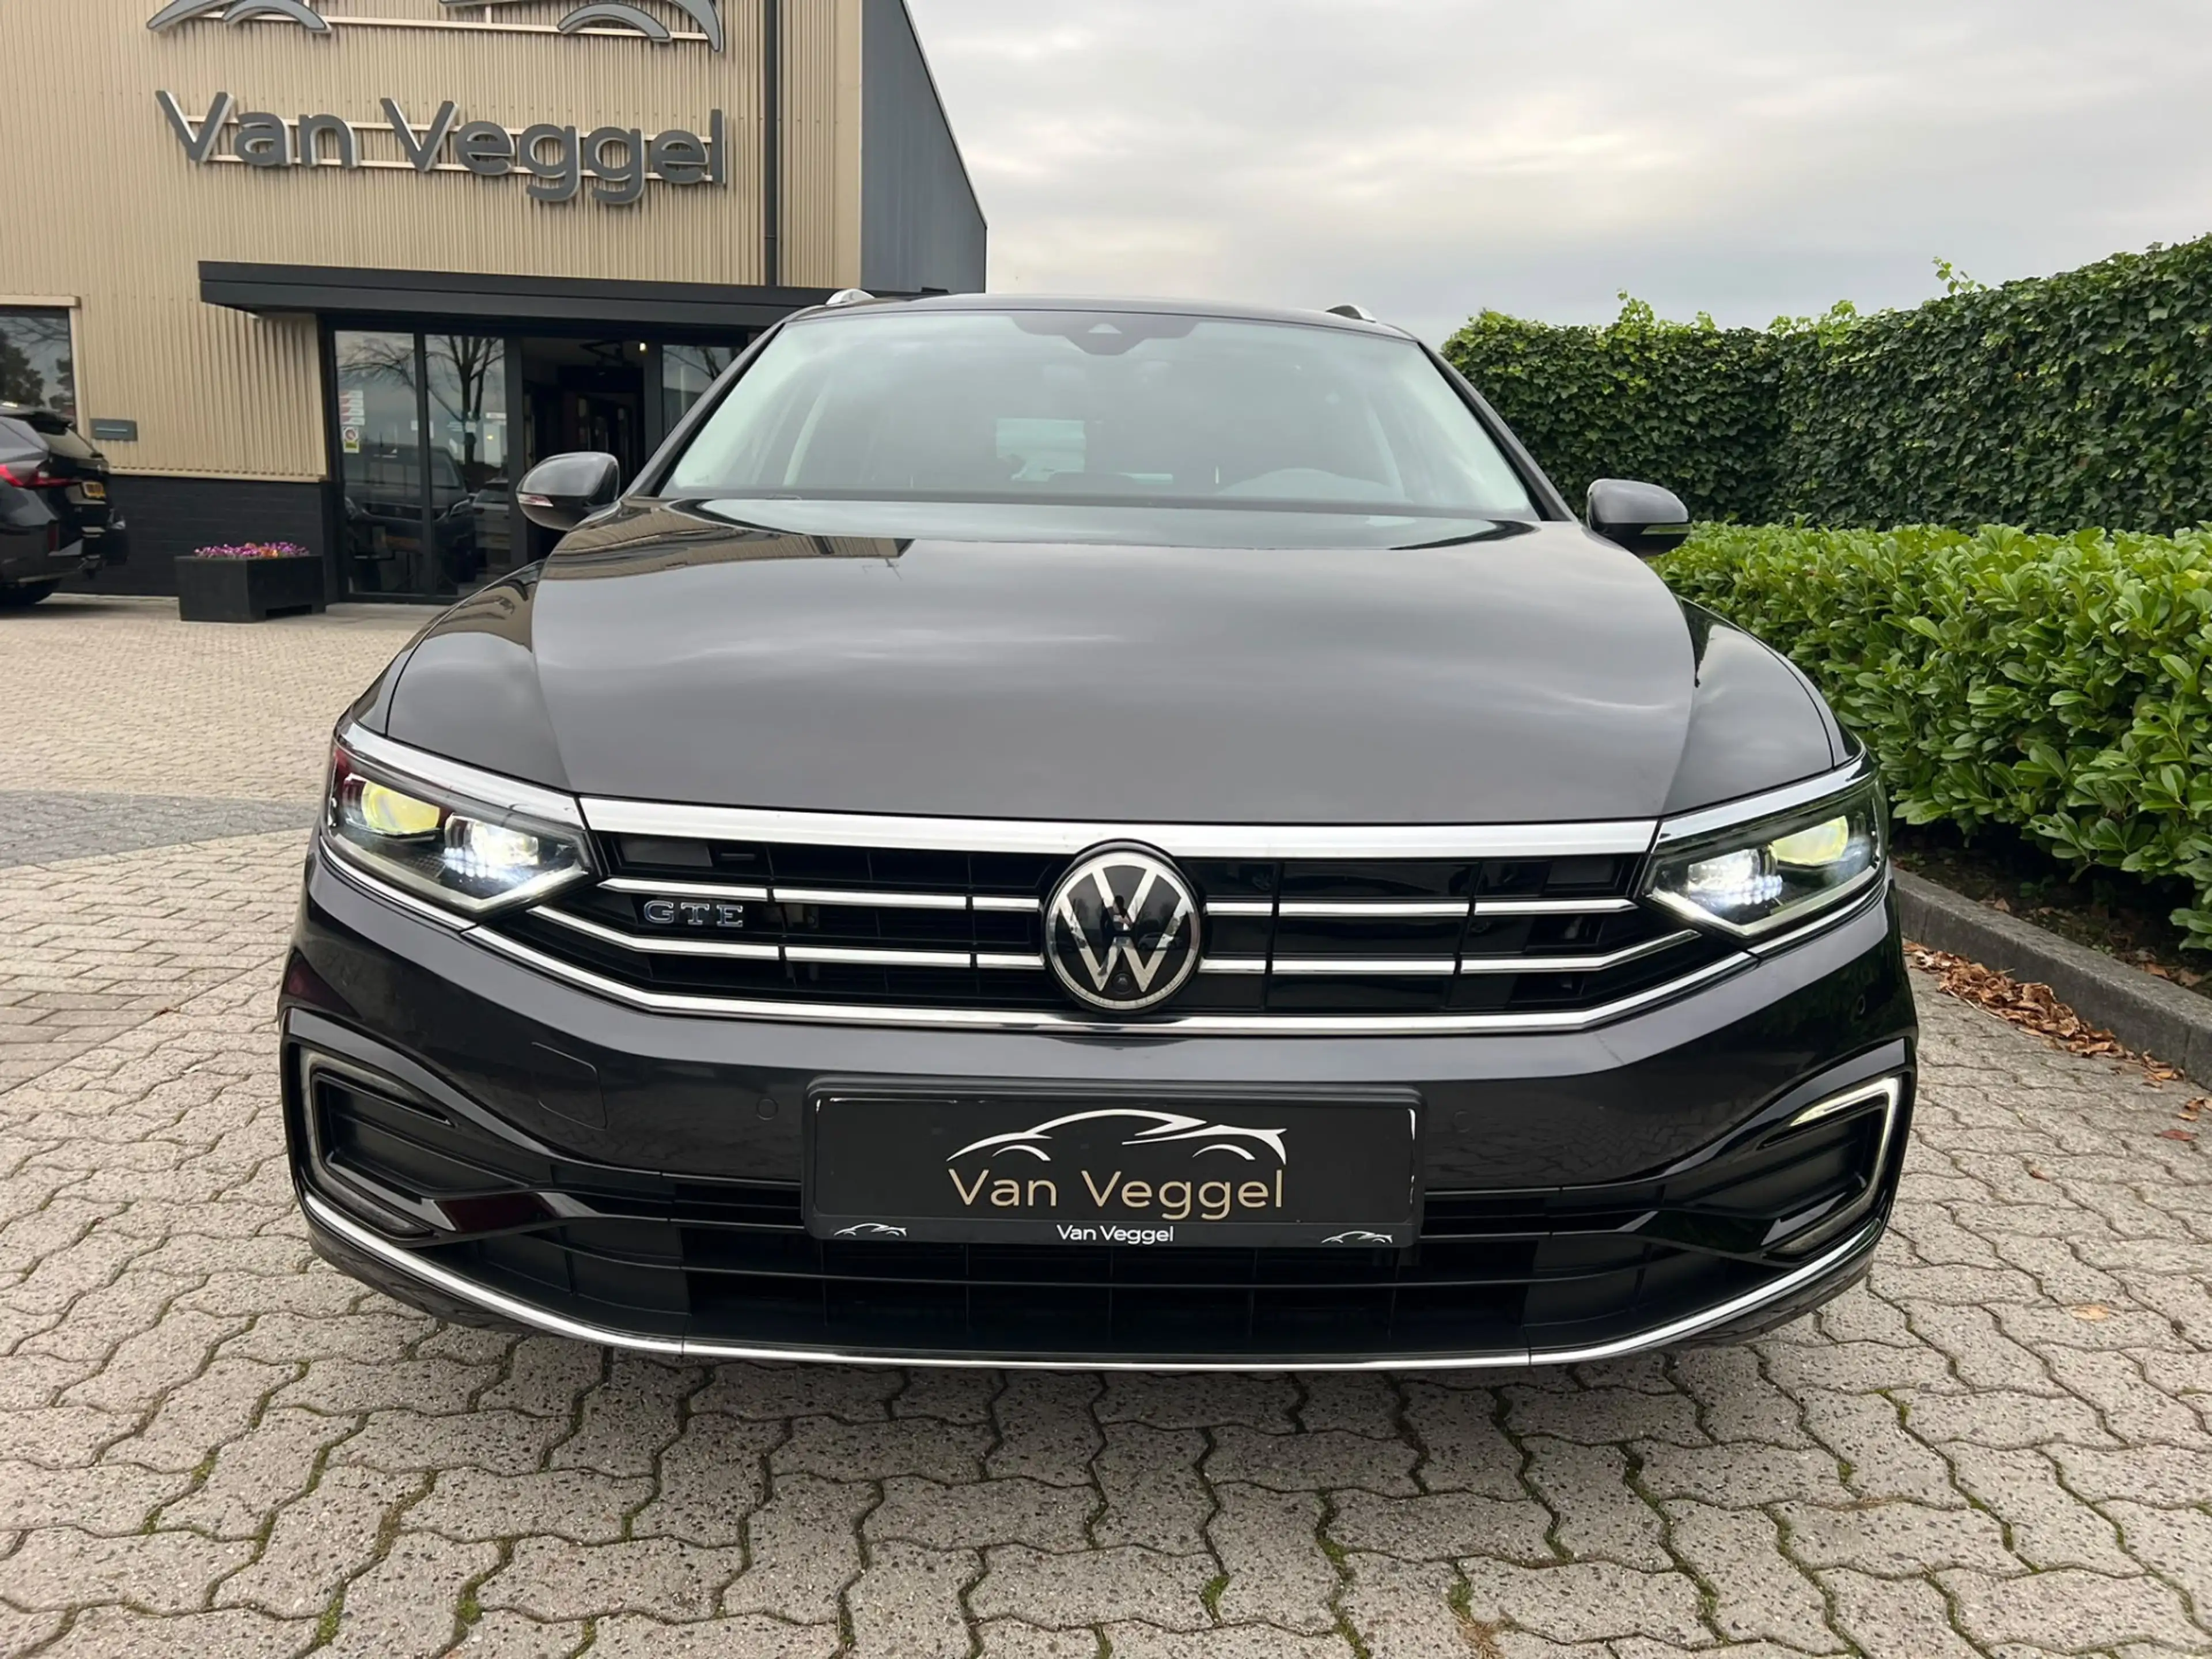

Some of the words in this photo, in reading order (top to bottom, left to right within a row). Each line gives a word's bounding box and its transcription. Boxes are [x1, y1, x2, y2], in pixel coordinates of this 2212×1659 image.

[156, 90, 358, 168] Van
[380, 97, 726, 204] Veggel
[644, 900, 743, 927] GTE
[1051, 858, 1195, 1002] VW
[948, 1169, 1057, 1207] Van
[1081, 1169, 1283, 1221] Veggel
[1056, 1225, 1096, 1241] Van
[1101, 1226, 1173, 1245] Veggel
